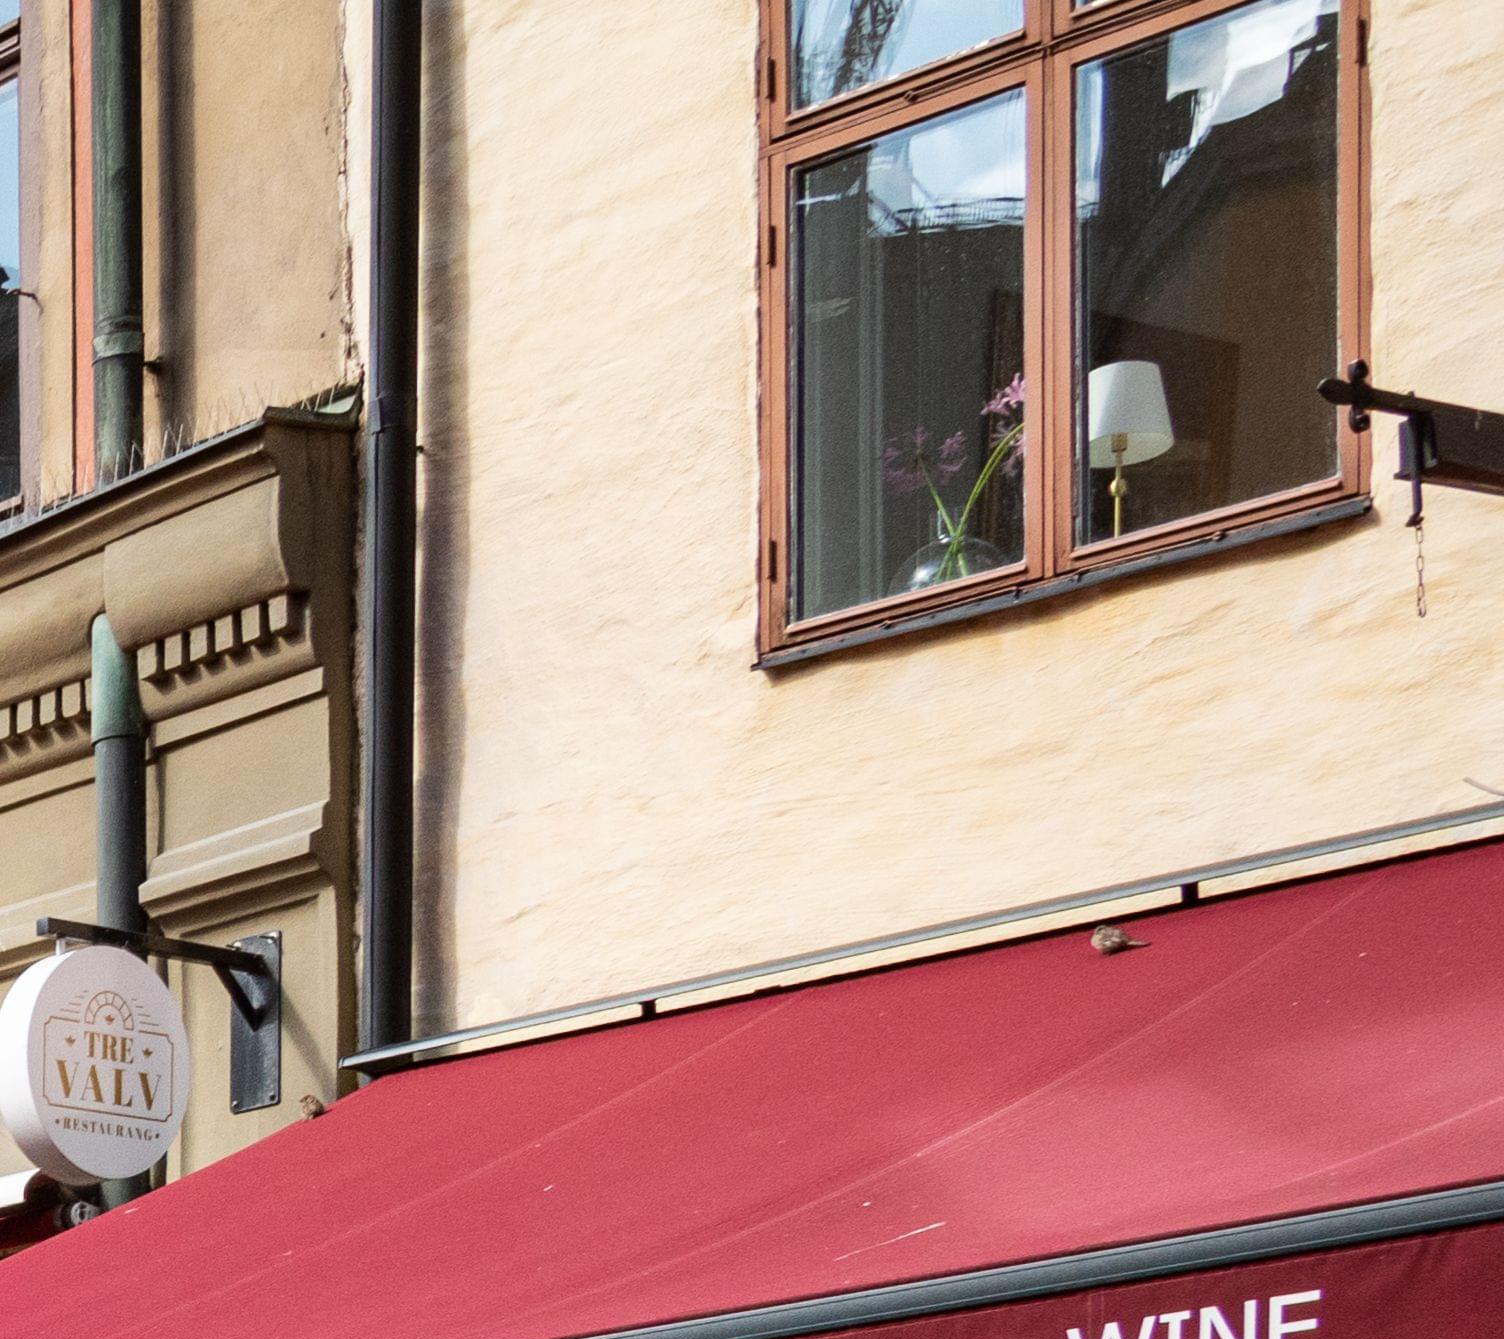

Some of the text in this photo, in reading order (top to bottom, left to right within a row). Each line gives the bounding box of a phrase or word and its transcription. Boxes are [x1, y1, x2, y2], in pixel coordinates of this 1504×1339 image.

[83, 1030, 135, 1065] TRE
[55, 1059, 163, 1112] VALV
[62, 1116, 153, 1142] RESTAURANG
